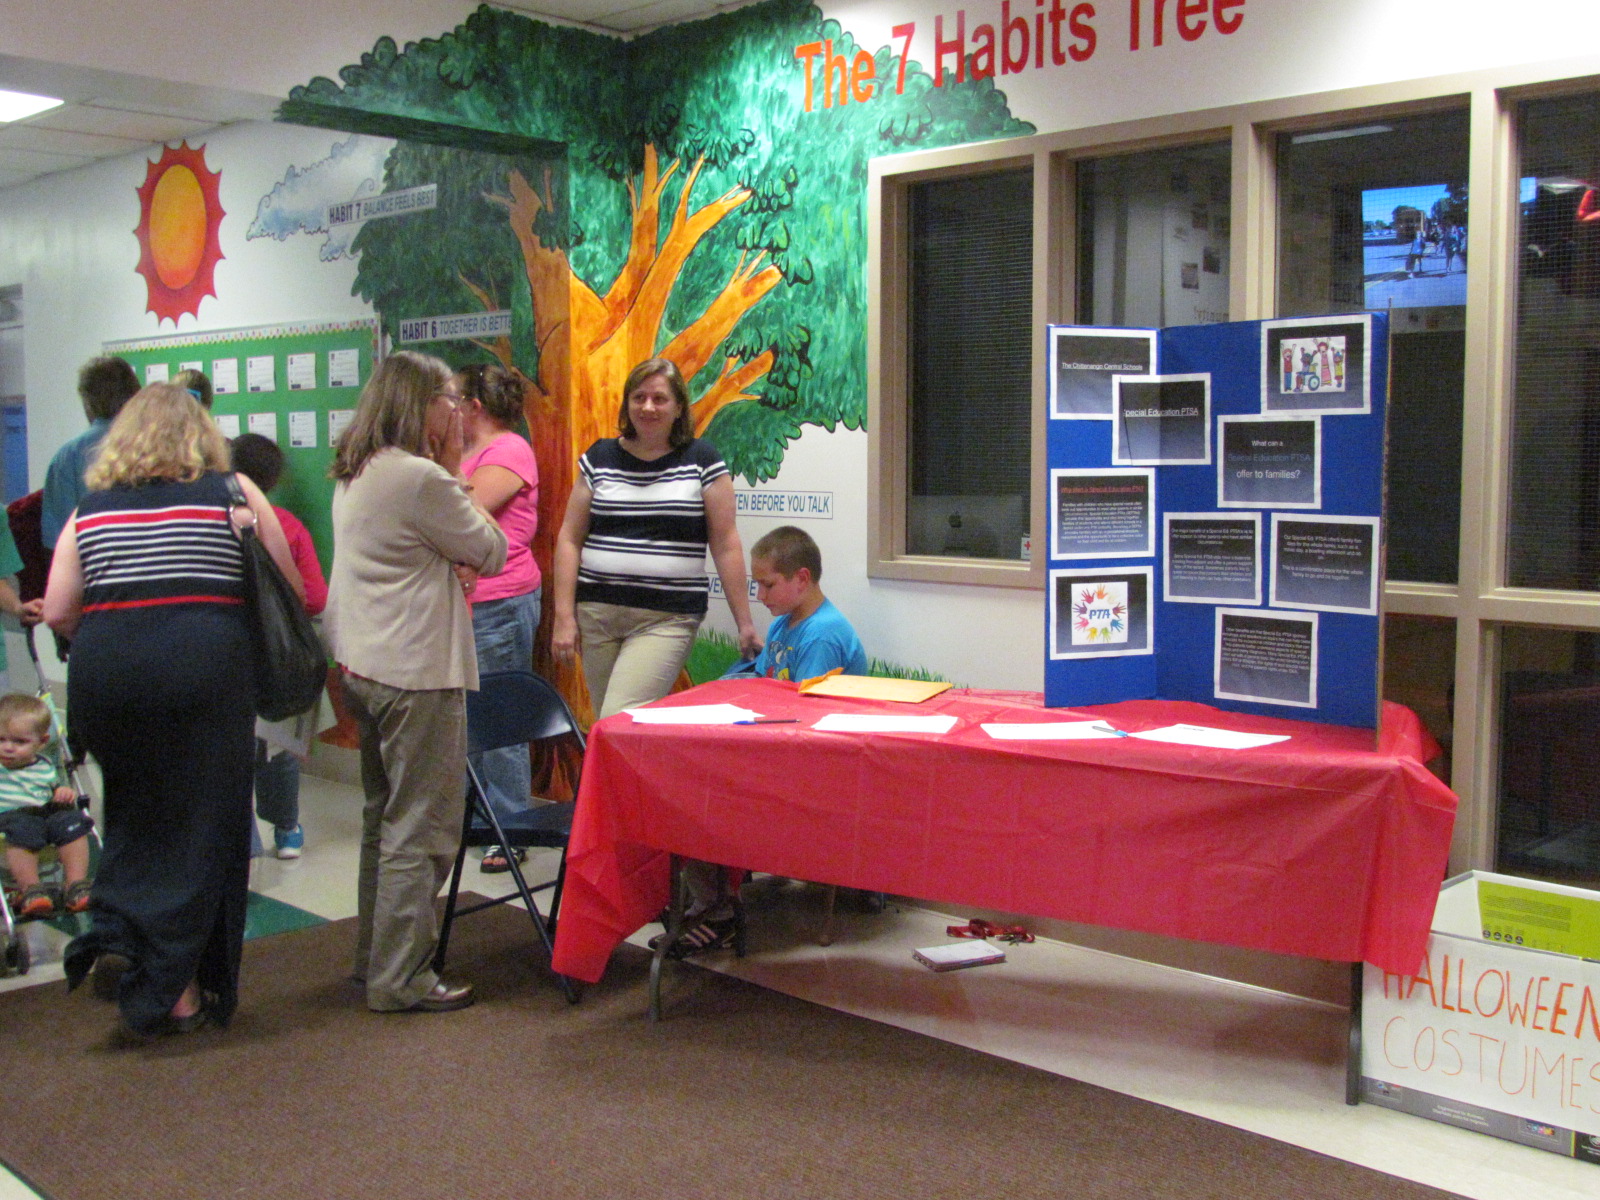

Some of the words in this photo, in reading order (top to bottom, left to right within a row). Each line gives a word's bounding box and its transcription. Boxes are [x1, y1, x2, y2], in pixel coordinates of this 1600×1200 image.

[795, 38, 876, 112] The
[891, 22, 916, 95] 7
[934, 0, 1097, 88] Habits
[1127, 0, 1245, 51] Tree
[329, 203, 353, 224] HABIT
[355, 202, 362, 219] 7
[363, 197, 393, 217] BALANCE
[416, 189, 435, 207] BEST
[402, 321, 428, 340] HABIT
[431, 320, 438, 338] 6
[440, 317, 478, 335] TOGETHER
[480, 316, 487, 332] IS
[1148, 408, 1180, 417] Education
[1181, 407, 1199, 416] PTSA
[1236, 470, 1253, 478] offer
[1254, 470, 1263, 478] to
[1265, 469, 1301, 479] families?
[751, 494, 785, 511] BEFORE
[788, 495, 805, 512] YOU
[808, 495, 830, 513] TALK
[1089, 609, 1111, 620] PTA
